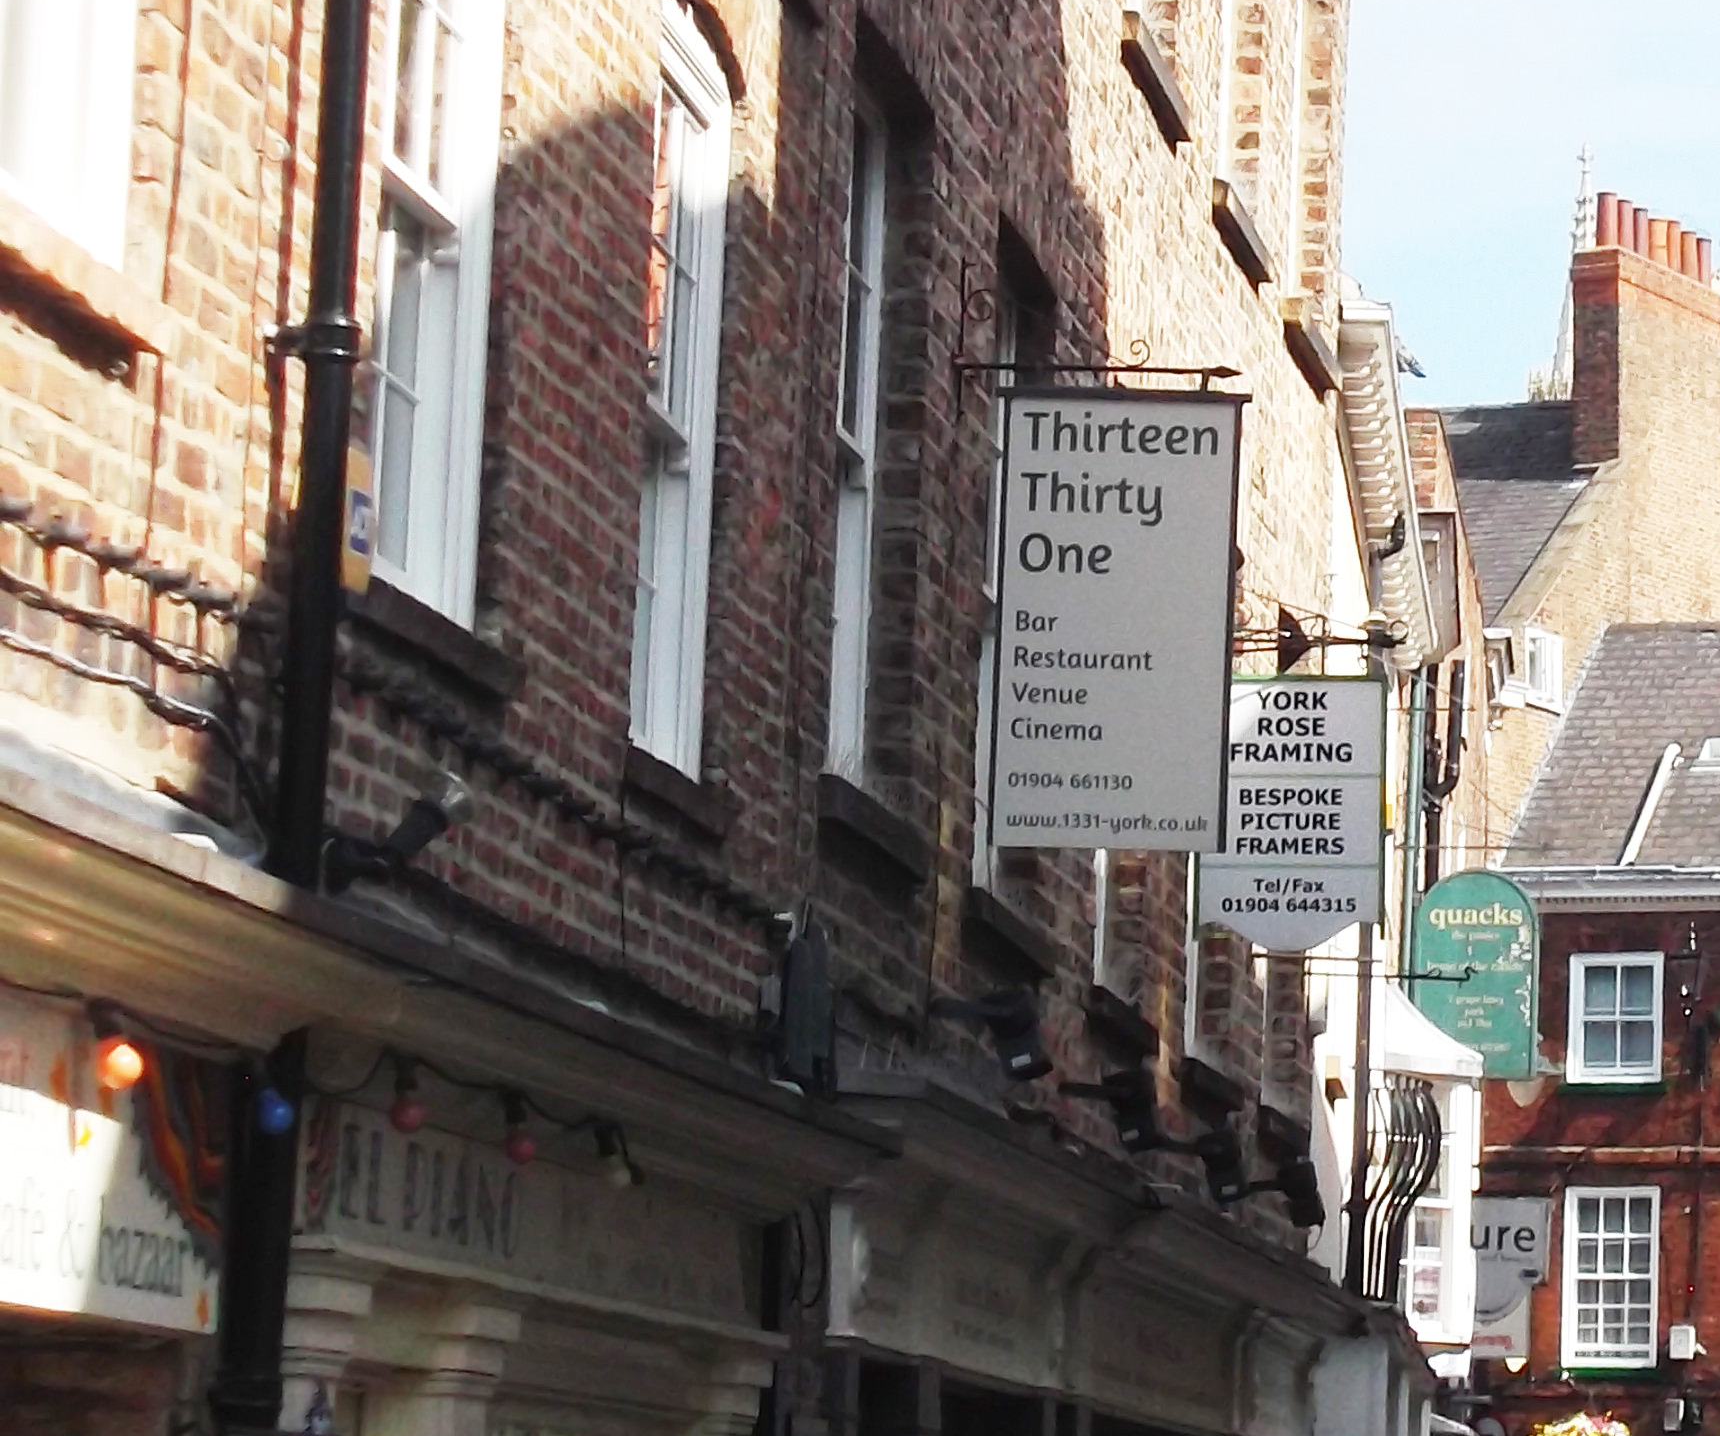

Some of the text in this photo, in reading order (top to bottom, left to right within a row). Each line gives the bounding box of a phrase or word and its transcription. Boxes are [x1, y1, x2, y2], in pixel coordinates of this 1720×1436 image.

[1023, 410, 1219, 456] Thirteen
[1021, 471, 1164, 526] Thirty
[1018, 532, 1113, 574] One
[1015, 609, 1059, 633] Bar
[1013, 645, 1154, 671] Restaurant
[1012, 681, 1089, 705] Venue
[1257, 691, 1328, 711] YORK
[1010, 716, 1103, 742] Cinema
[1257, 716, 1326, 737] ROSE
[1230, 742, 1353, 763] FRAMING
[1008, 772, 1133, 791] 01904 661130
[1239, 788, 1343, 807] BESPOKE
[1006, 812, 1208, 834] www.1331-york.co.uk
[1240, 812, 1341, 831] PICTURE
[1236, 836, 1345, 855] FRAMERS
[1253, 877, 1324, 895] Tel/Fax
[1222, 897, 1357, 914] 01904 644315
[1429, 902, 1523, 931] quacks
[0, 1175, 46, 1273] afé
[1471, 1225, 1536, 1253] ure
